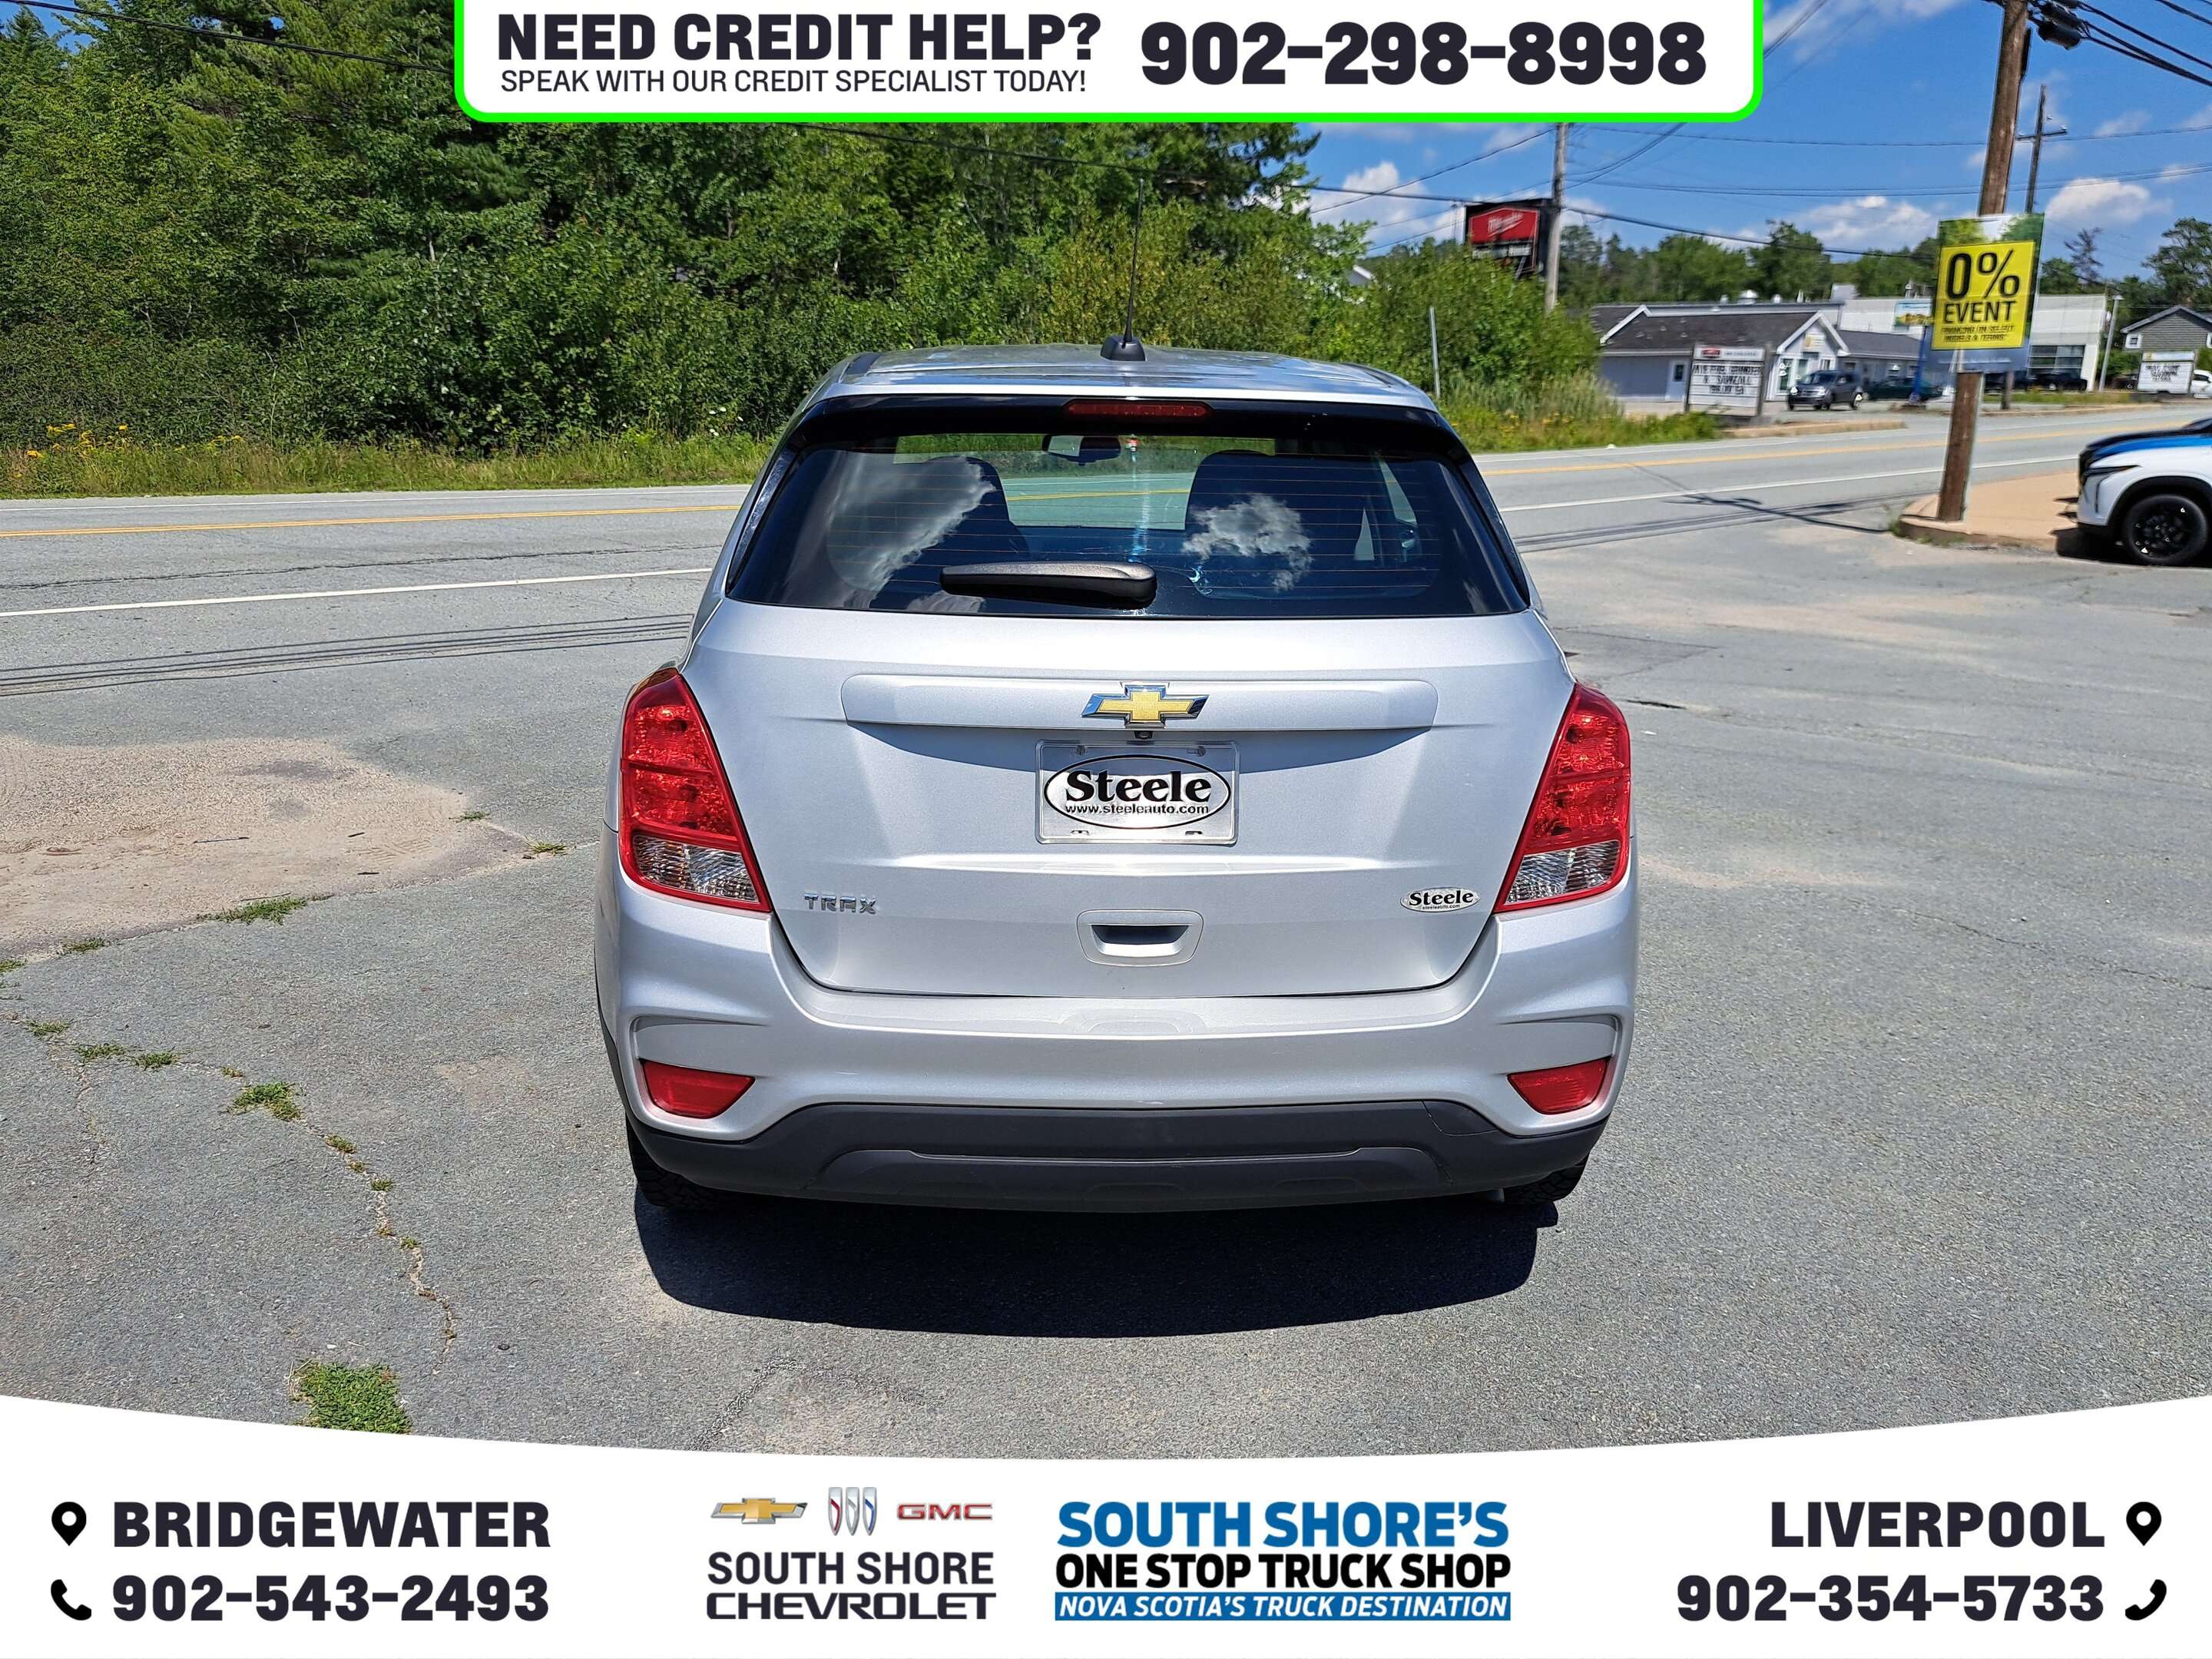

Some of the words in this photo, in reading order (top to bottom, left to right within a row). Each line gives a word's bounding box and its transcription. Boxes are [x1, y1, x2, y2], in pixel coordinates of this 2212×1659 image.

[1947, 250, 2020, 299] 0%
[1943, 301, 2017, 323] EVENT
[1065, 770, 1211, 803] Steele
[1066, 803, 1209, 815] www.steeleauto.com
[804, 893, 876, 915] TRAX
[1409, 890, 1474, 906] Steele
